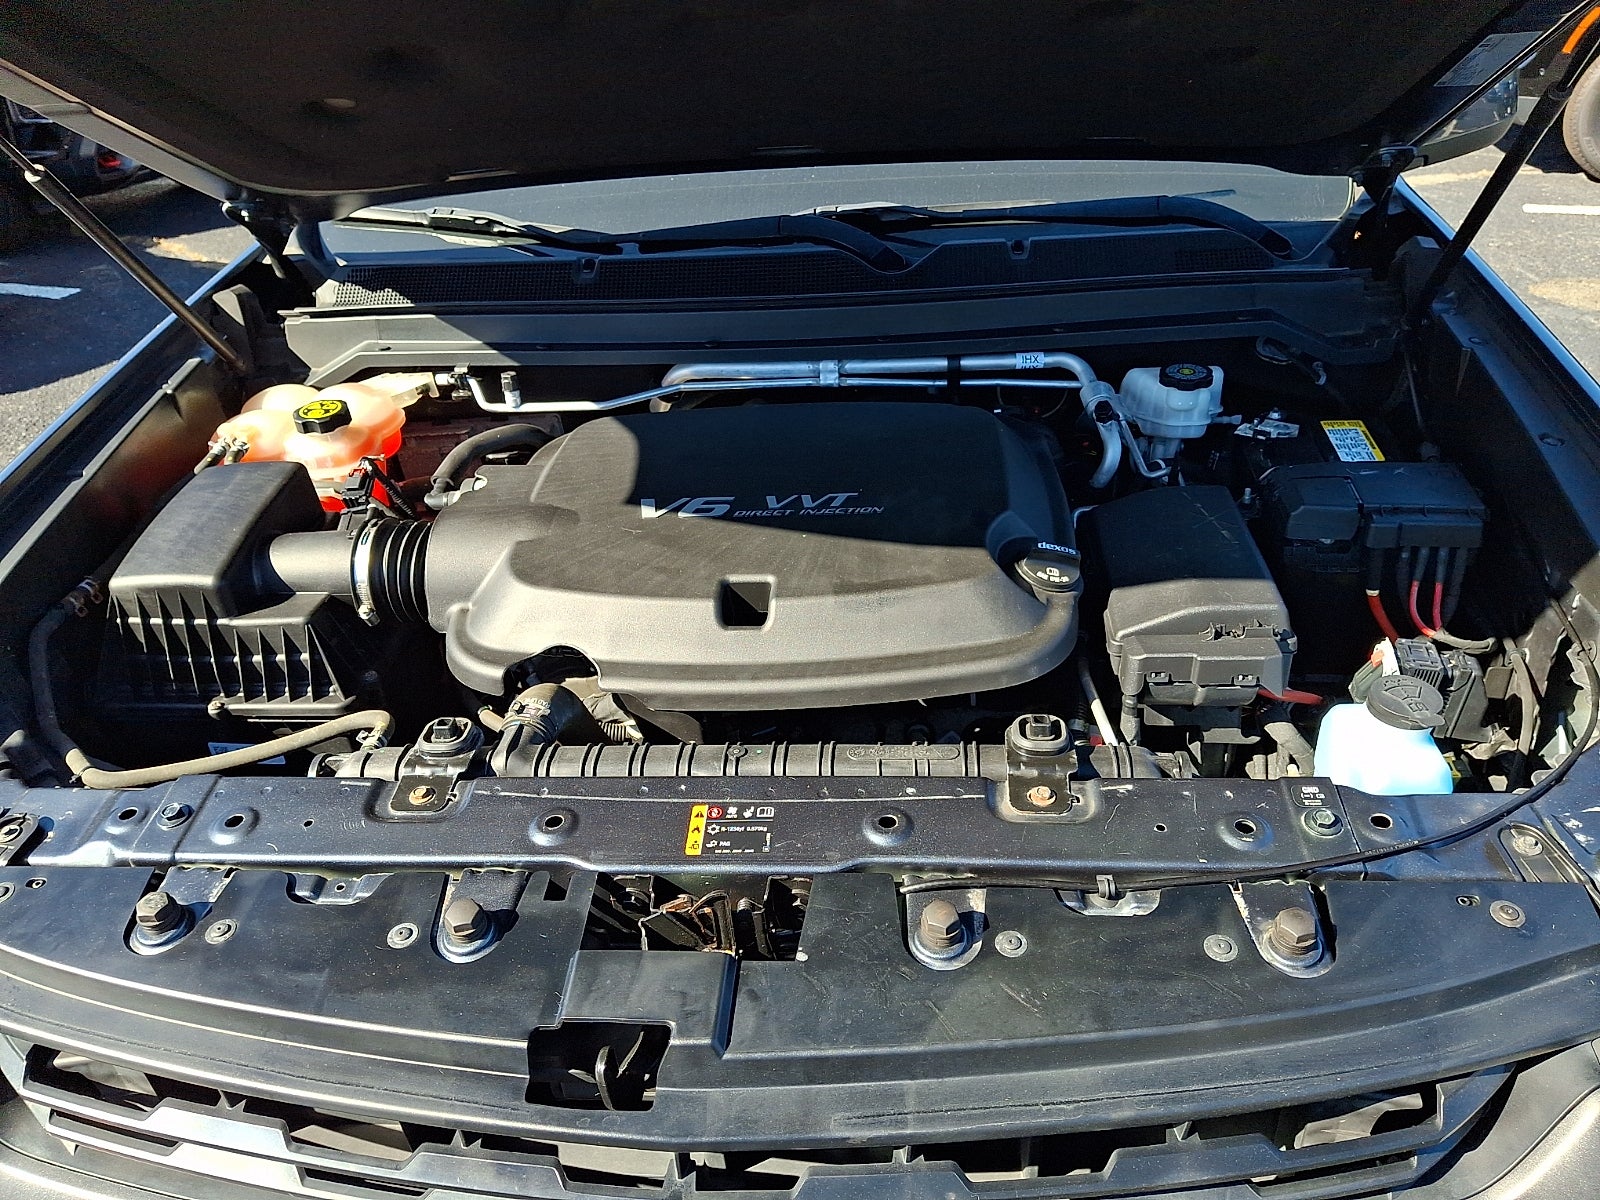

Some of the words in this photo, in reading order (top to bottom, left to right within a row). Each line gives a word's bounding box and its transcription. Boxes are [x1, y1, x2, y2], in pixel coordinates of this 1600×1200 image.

[1021, 354, 1039, 364] IHX
[640, 496, 736, 519] V6
[766, 492, 858, 509] VVT
[733, 509, 794, 518] DIRECT
[799, 506, 884, 516] INJECTION
[1037, 541, 1076, 555] dexos
